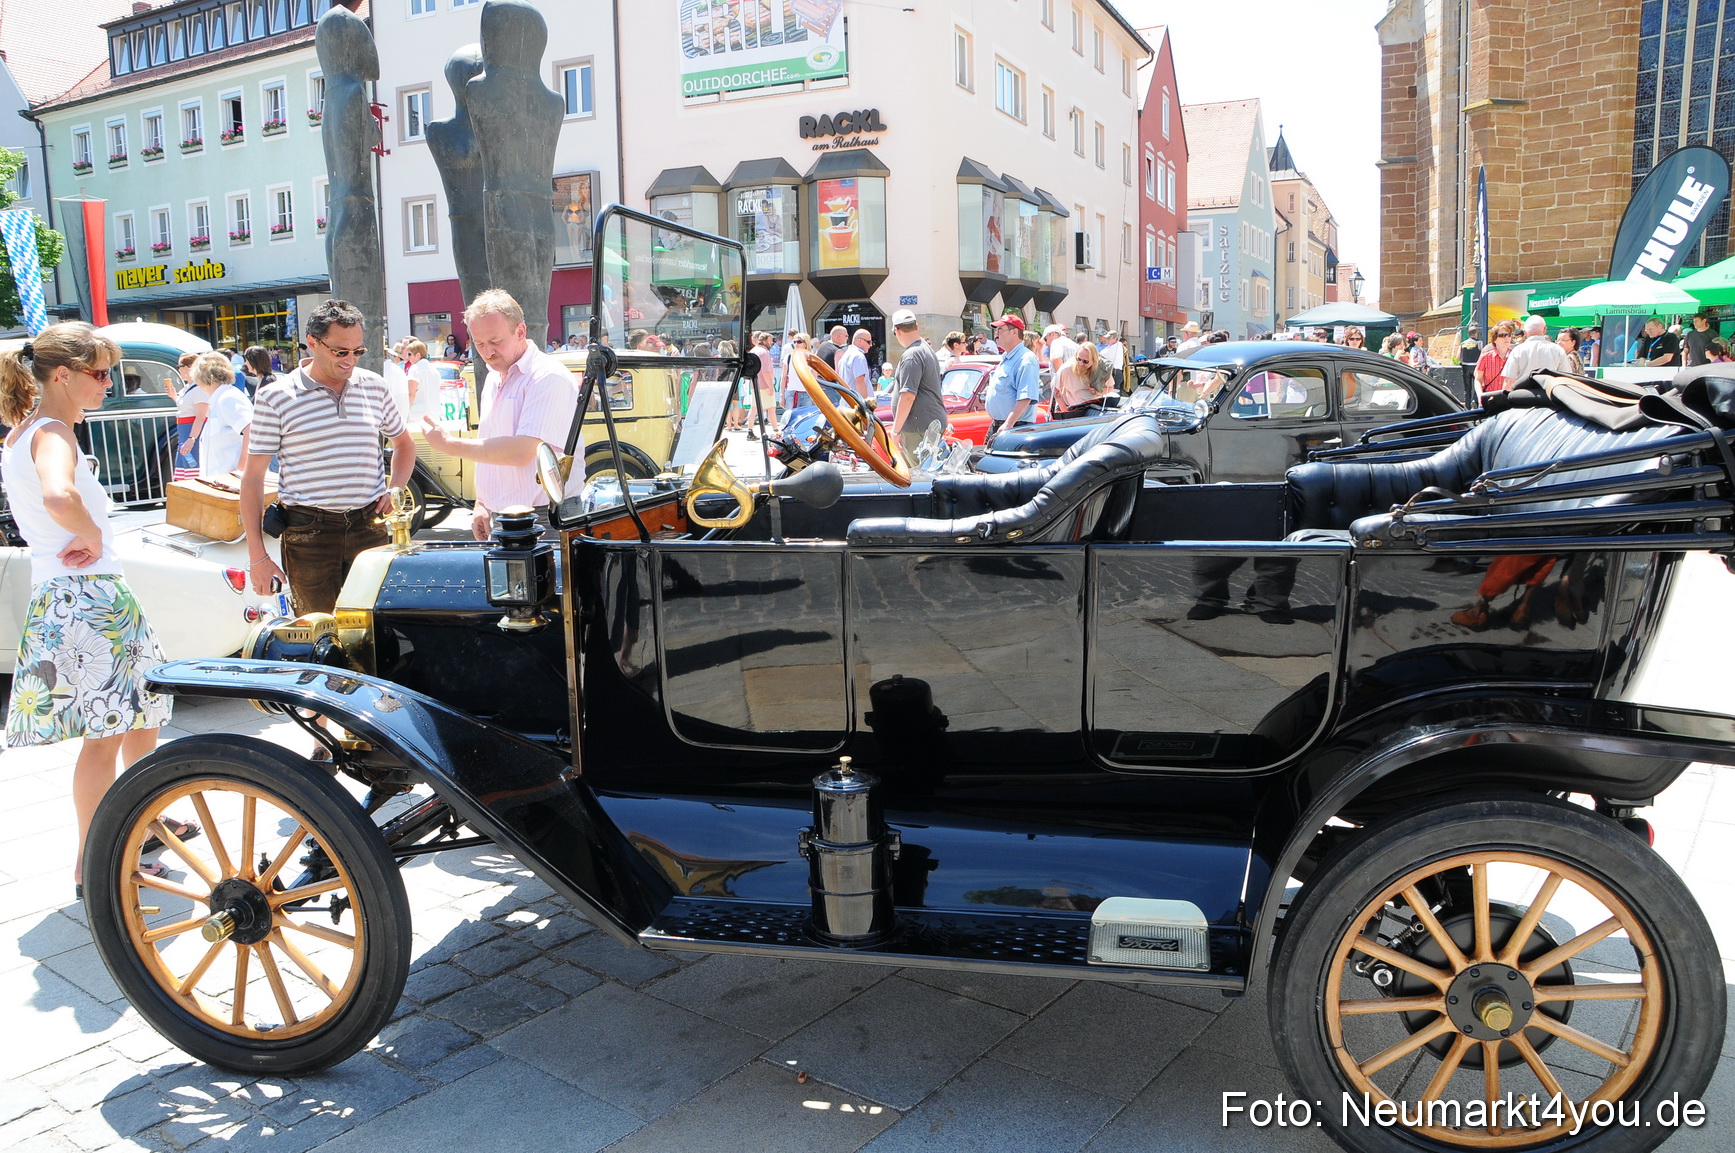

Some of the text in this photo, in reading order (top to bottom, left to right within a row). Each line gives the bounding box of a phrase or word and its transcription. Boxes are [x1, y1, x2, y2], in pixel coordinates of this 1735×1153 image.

[683, 67, 801, 93] OUTDOORCHEF.com
[799, 108, 887, 139] RACKL
[812, 136, 879, 151] am Rathaus
[738, 199, 763, 214] RACKL
[1690, 189, 1710, 217] SWEDEN
[115, 258, 226, 290] mayer schuhe
[1220, 225, 1231, 303] satzke
[842, 314, 861, 324] RACKL
[1120, 937, 1178, 951] Ford
